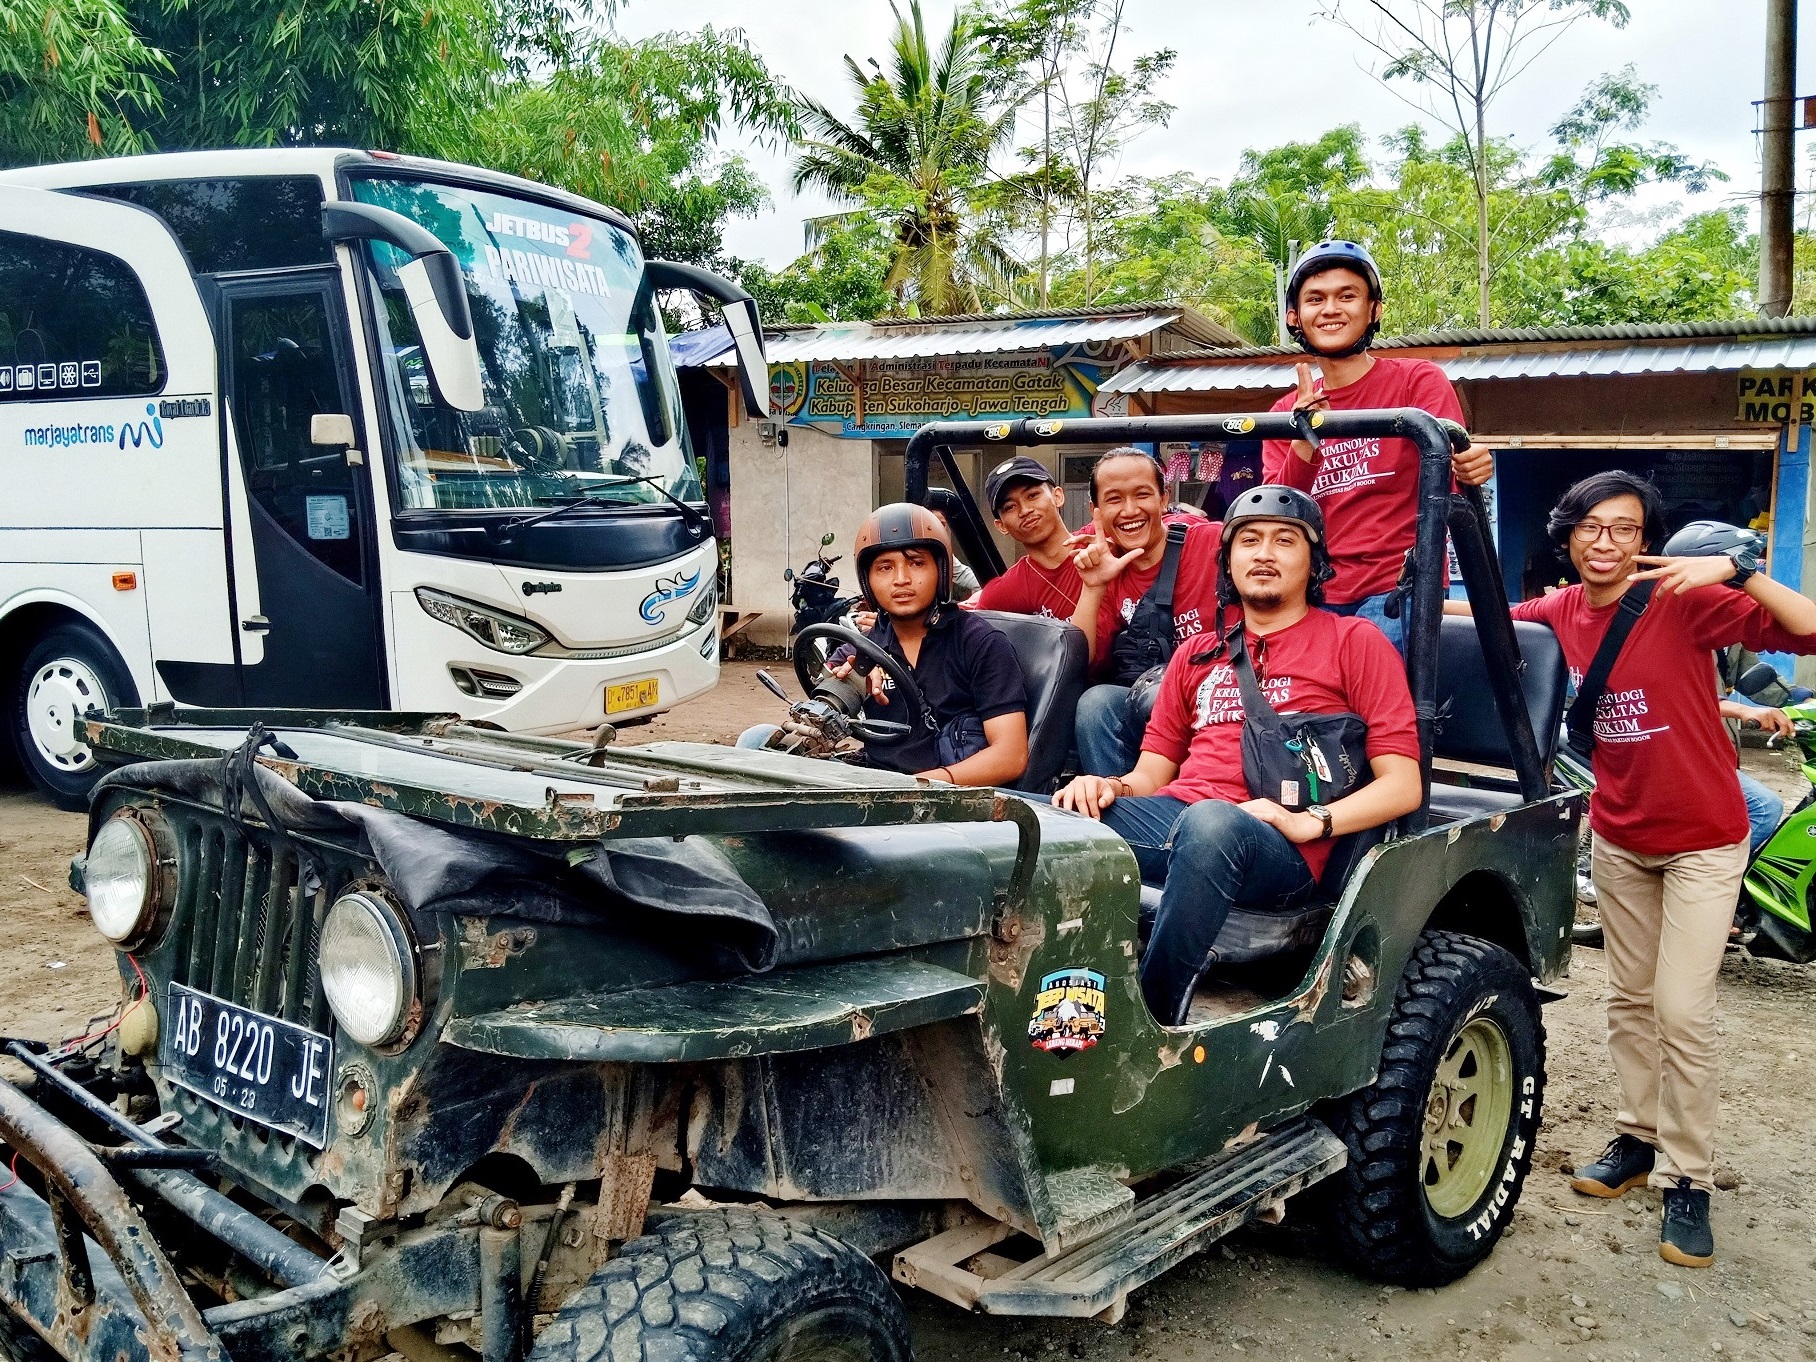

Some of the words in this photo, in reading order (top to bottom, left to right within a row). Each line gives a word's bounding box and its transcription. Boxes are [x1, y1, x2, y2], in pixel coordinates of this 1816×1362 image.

[484, 245, 612, 298] PARIWISATA
[870, 360, 936, 373] Administrasi
[937, 358, 981, 373] Terpadu
[815, 377, 877, 397] Keluaga
[881, 376, 922, 395] Besar
[924, 372, 1009, 392] Kecamatan
[1013, 369, 1063, 389] Gatak
[810, 399, 884, 417] Kabupten
[887, 395, 961, 416] Sukoharjo
[970, 394, 1010, 416] Jawa
[1014, 394, 1068, 416] Tengah
[24, 423, 115, 448] marjayatrans
[1048, 979, 1097, 990] ASOSIASI
[1032, 987, 1066, 1018] JEEP
[1065, 986, 1105, 1018] WISATA
[174, 996, 203, 1056] AB
[214, 1010, 275, 1085] 8220
[291, 1037, 323, 1106] JE
[1521, 1076, 1535, 1119] GT
[1466, 1135, 1526, 1240] RADIAL
